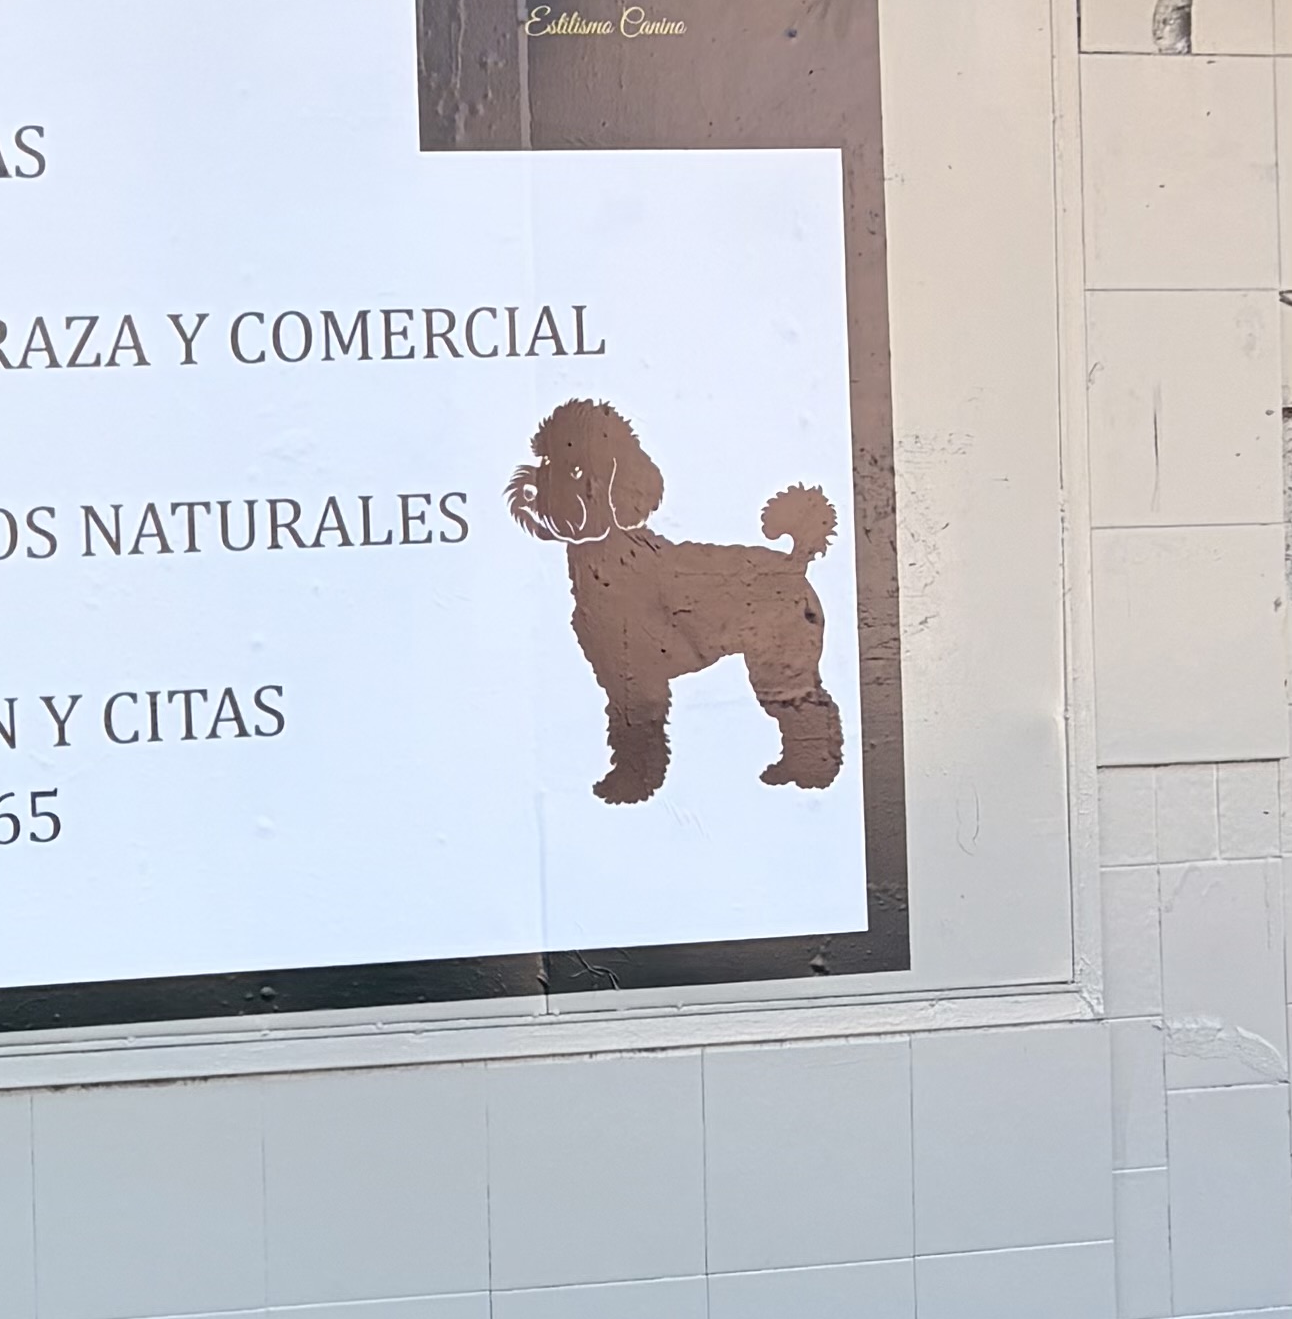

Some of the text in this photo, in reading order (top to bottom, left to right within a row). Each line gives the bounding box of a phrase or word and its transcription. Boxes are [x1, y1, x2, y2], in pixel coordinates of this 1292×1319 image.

[524, 5, 687, 38] Estilismo Canino
[166, 313, 210, 366] Y
[229, 304, 607, 364] COMERCIAL
[80, 491, 470, 557] NATURALES
[39, 694, 84, 747] Y
[102, 684, 286, 745] CITAS
